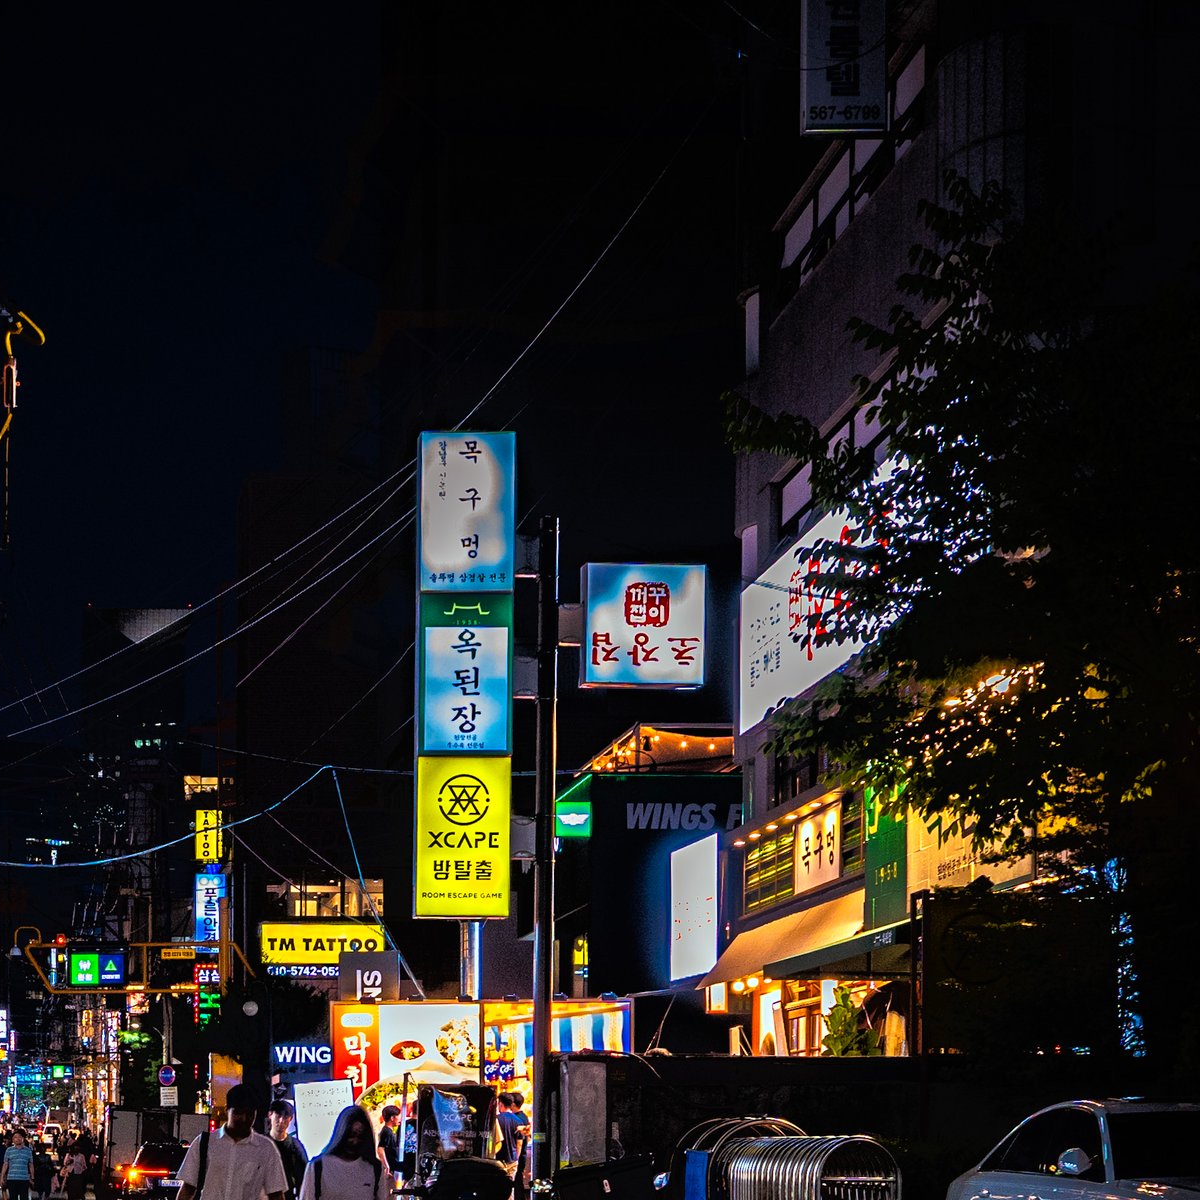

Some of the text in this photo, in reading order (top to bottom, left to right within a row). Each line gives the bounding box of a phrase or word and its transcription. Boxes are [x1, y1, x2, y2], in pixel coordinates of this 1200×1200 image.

[459, 440, 482, 559] 목구멍
[451, 629, 482, 733] 옥된장
[626, 802, 715, 830] WINGS
[428, 832, 500, 848] XCAPE
[801, 823, 835, 875] 목구멍
[433, 860, 493, 880] 방탈출
[267, 938, 378, 951] TM TATTOO
[275, 1046, 332, 1063] WING
